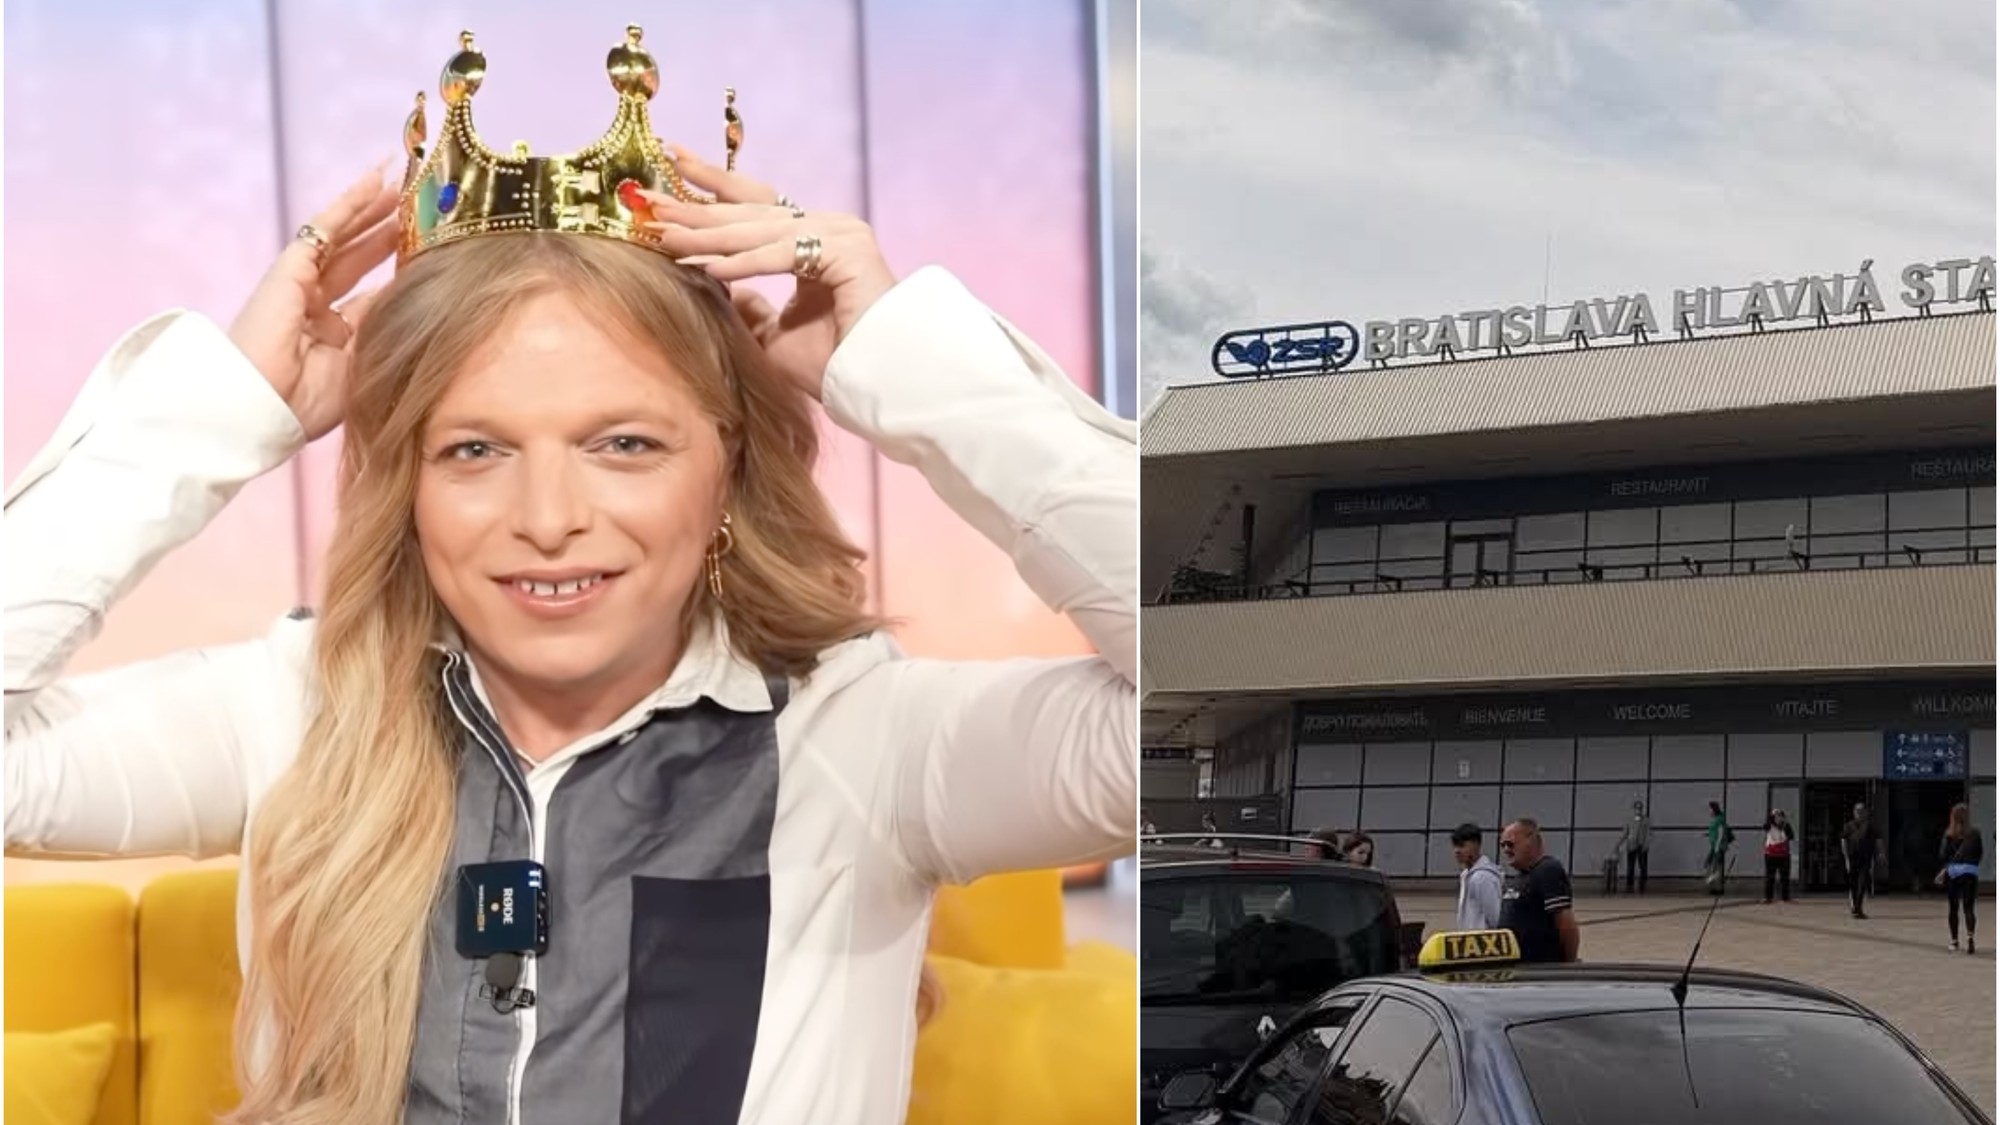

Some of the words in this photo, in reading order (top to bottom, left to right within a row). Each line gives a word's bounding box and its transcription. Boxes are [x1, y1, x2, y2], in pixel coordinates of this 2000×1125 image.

[1365, 293, 1660, 360] BRATISLAVA
[1672, 258, 1886, 330] HLAVNÁ
[1900, 255, 1996, 308] STA
[1465, 705, 1546, 724] BIENVENUE
[1613, 703, 1692, 721] WELCOME
[1447, 932, 1509, 958] TAXI
